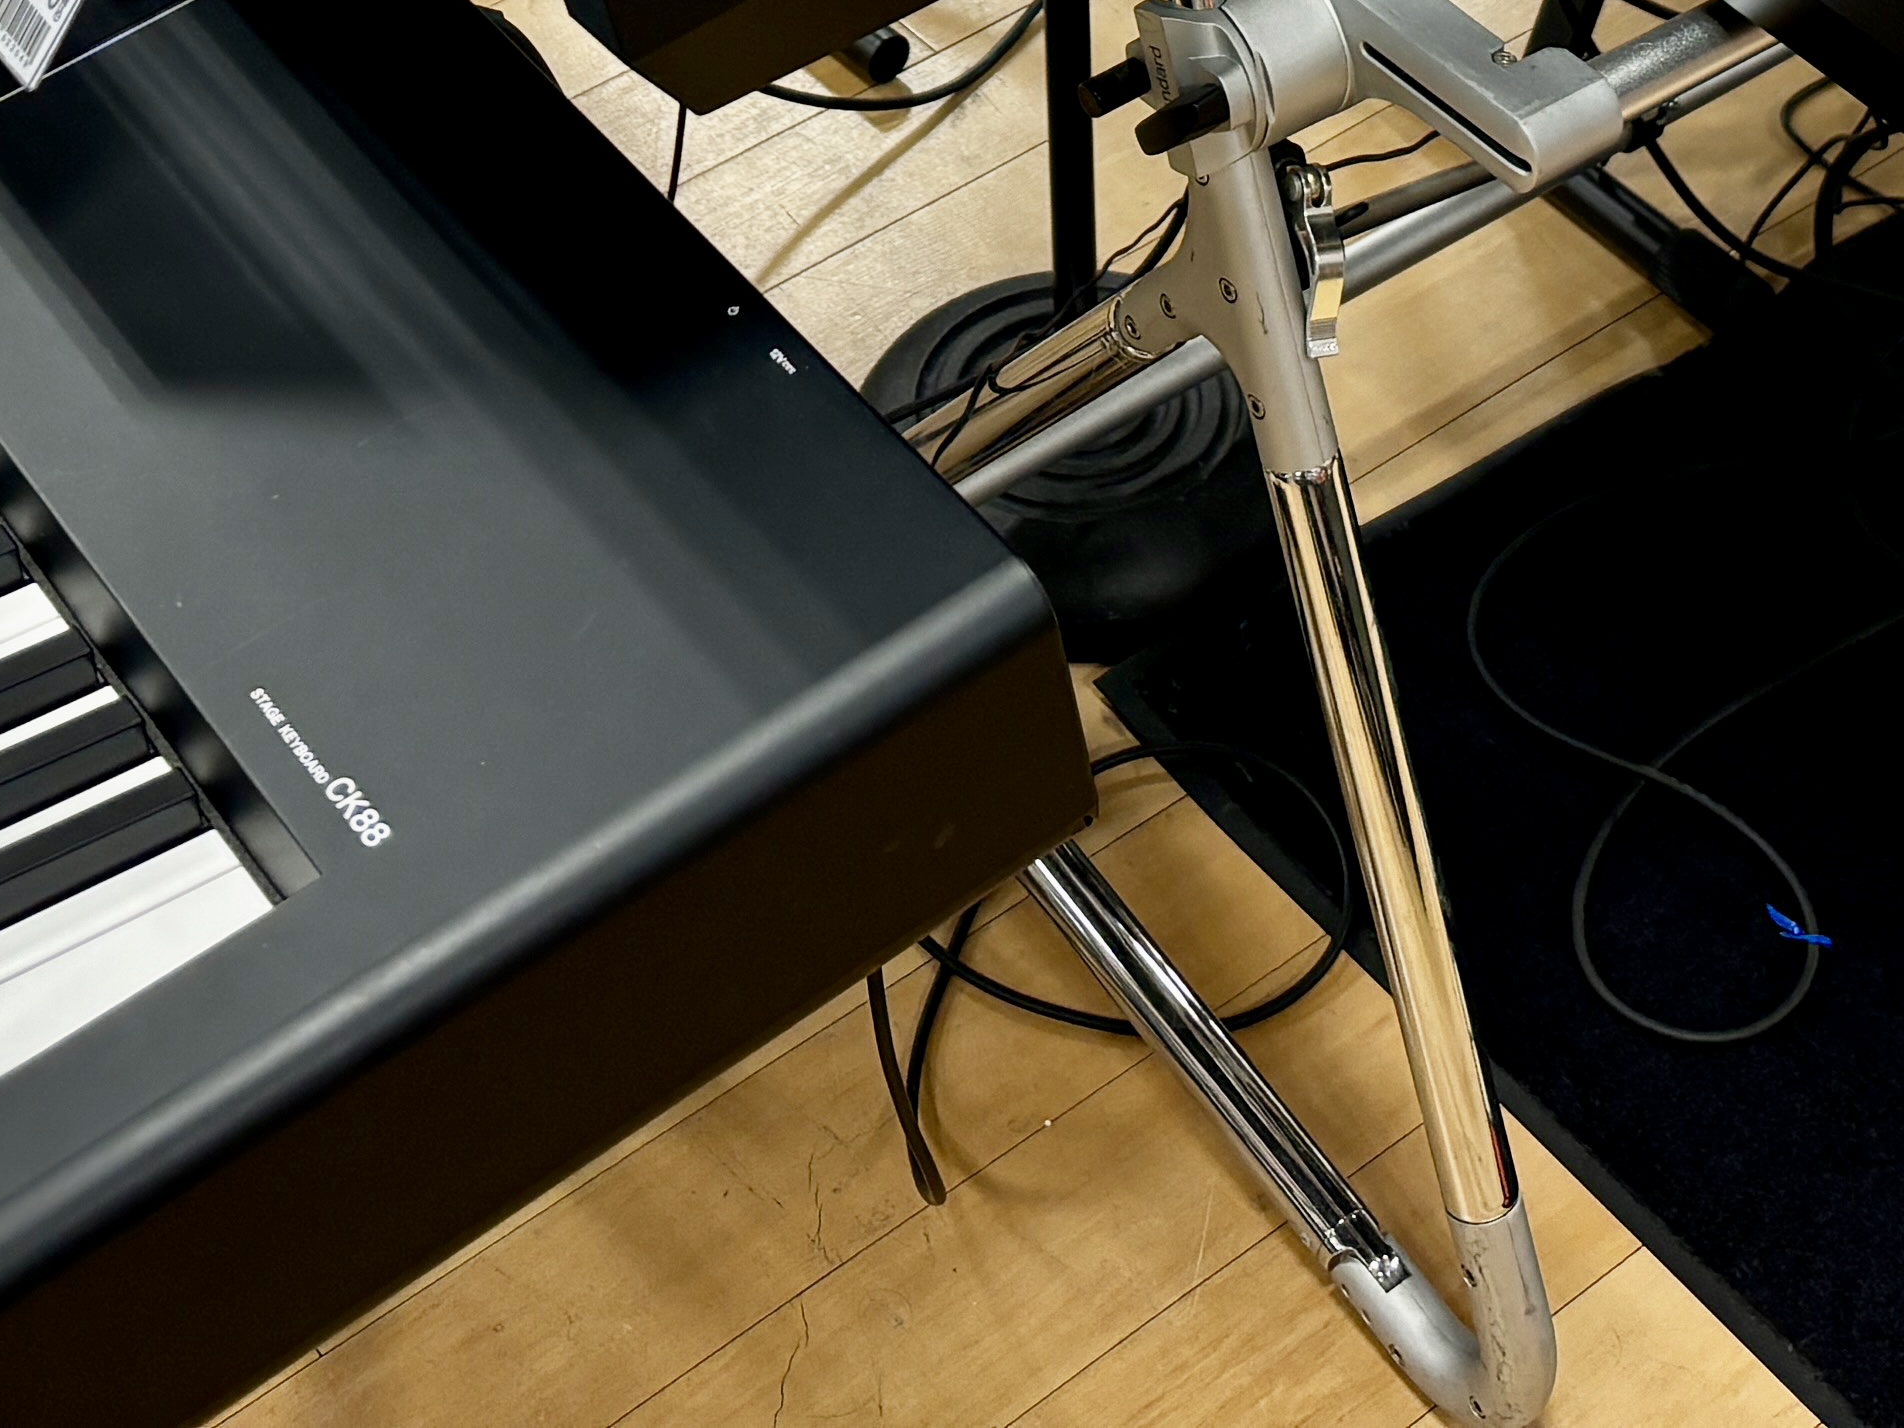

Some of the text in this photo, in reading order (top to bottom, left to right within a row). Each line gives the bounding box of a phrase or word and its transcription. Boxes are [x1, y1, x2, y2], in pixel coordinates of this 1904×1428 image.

[249, 686, 392, 848] STAGE KEYBOARD CK88
